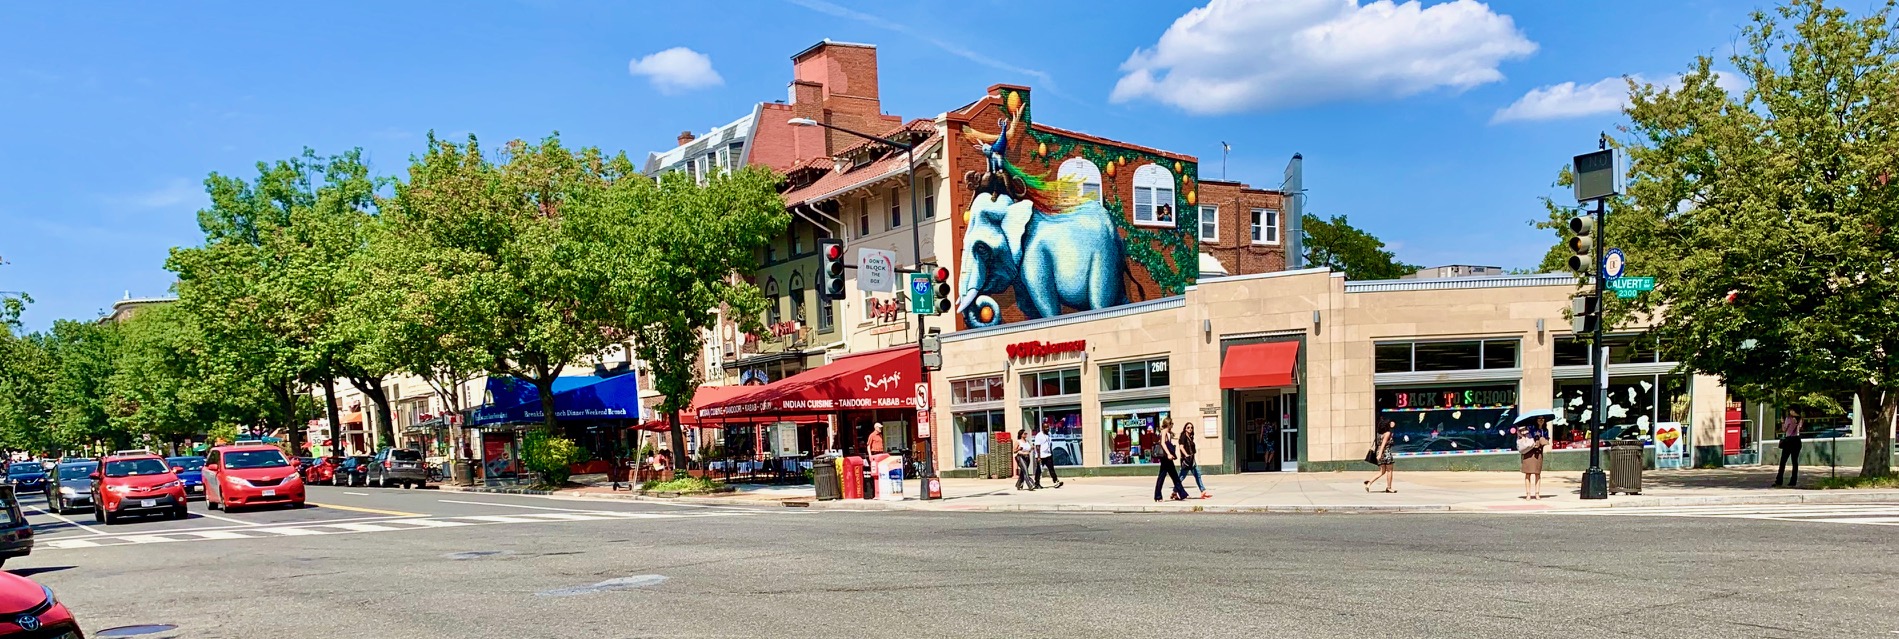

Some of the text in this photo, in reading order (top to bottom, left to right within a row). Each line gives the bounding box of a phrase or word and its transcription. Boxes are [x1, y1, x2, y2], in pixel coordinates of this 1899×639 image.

[916, 283, 927, 292] 495
[1606, 279, 1643, 289] CALVERT
[1151, 361, 1168, 373] 2601
[863, 371, 901, 392] Rajaji
[783, 400, 807, 409] INDIAN
[807, 399, 834, 408] CUISINE
[839, 398, 872, 407] TANDOORI
[877, 397, 900, 406] KABAB
[1395, 389, 1515, 408] BACK TO SCHOOL
